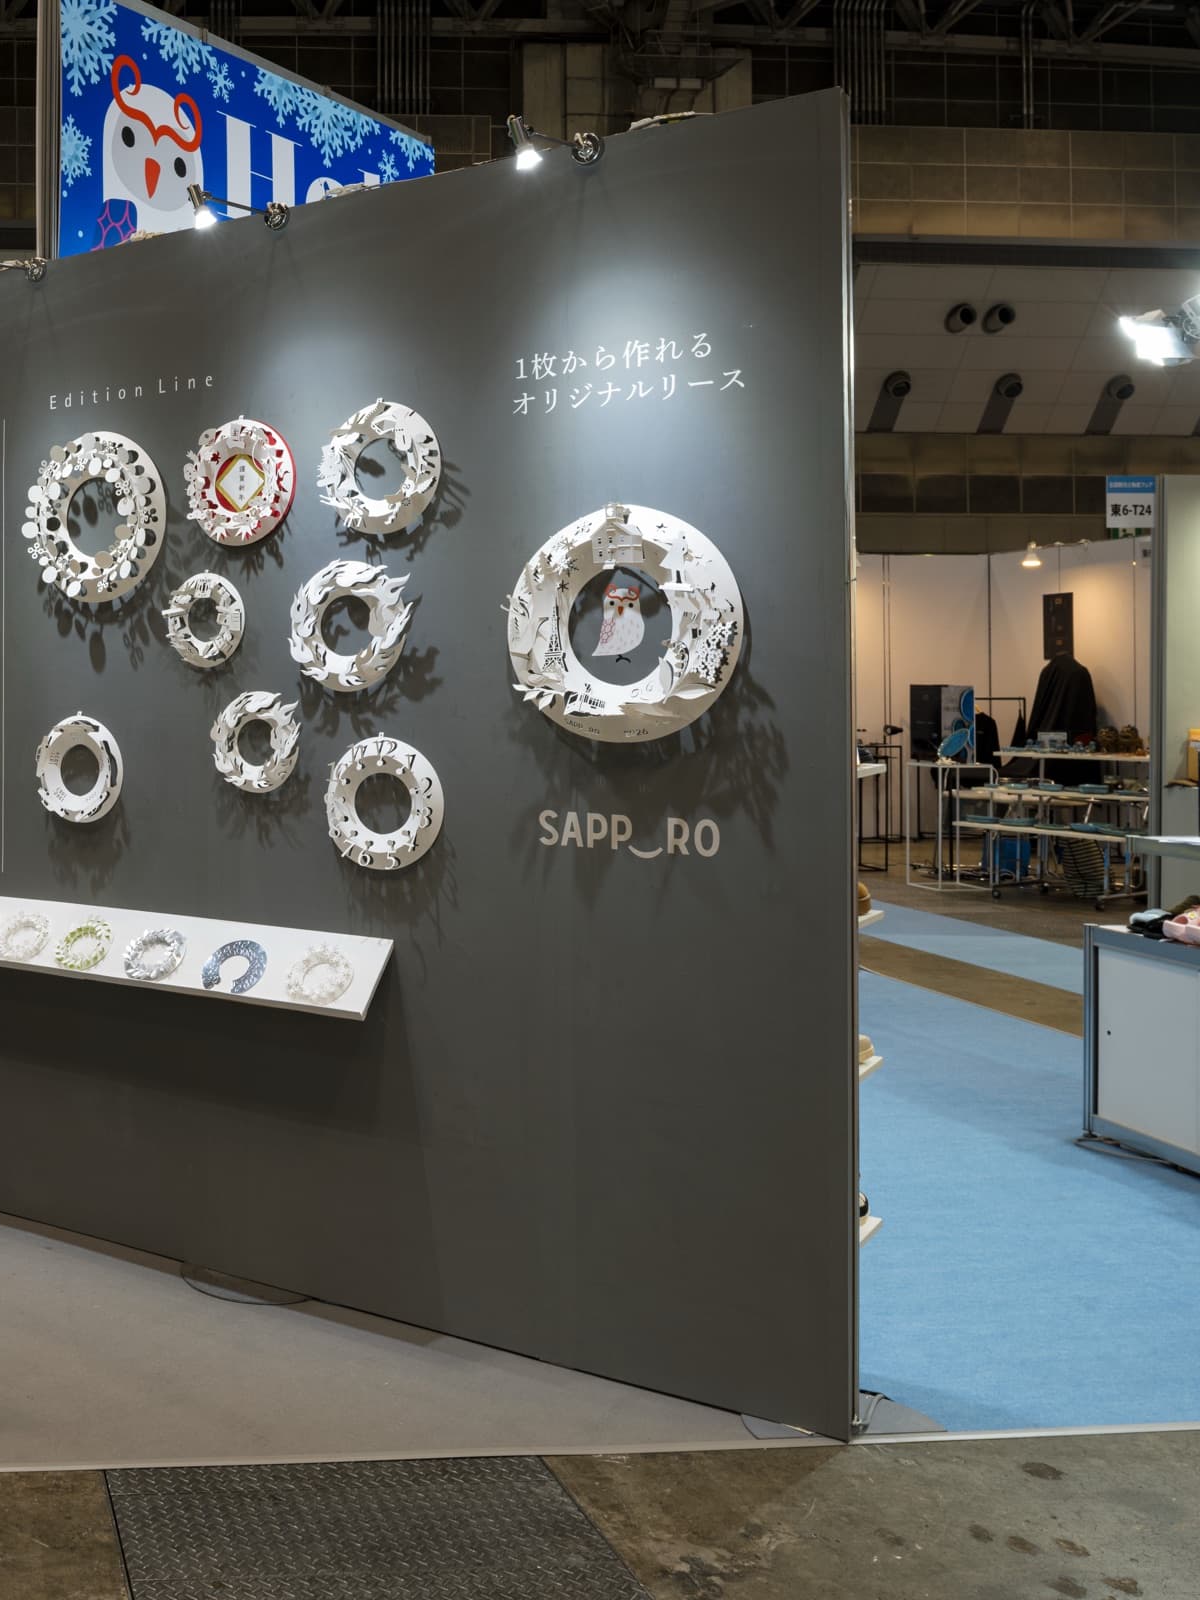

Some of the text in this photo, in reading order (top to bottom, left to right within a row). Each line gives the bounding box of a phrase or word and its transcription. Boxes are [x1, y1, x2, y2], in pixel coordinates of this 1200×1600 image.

[514, 333, 712, 380] 1枚から作れる
[50, 375, 213, 410] Edition Line
[512, 369, 745, 415] オリジナルリース
[1111, 503, 1152, 517] 東6-T24
